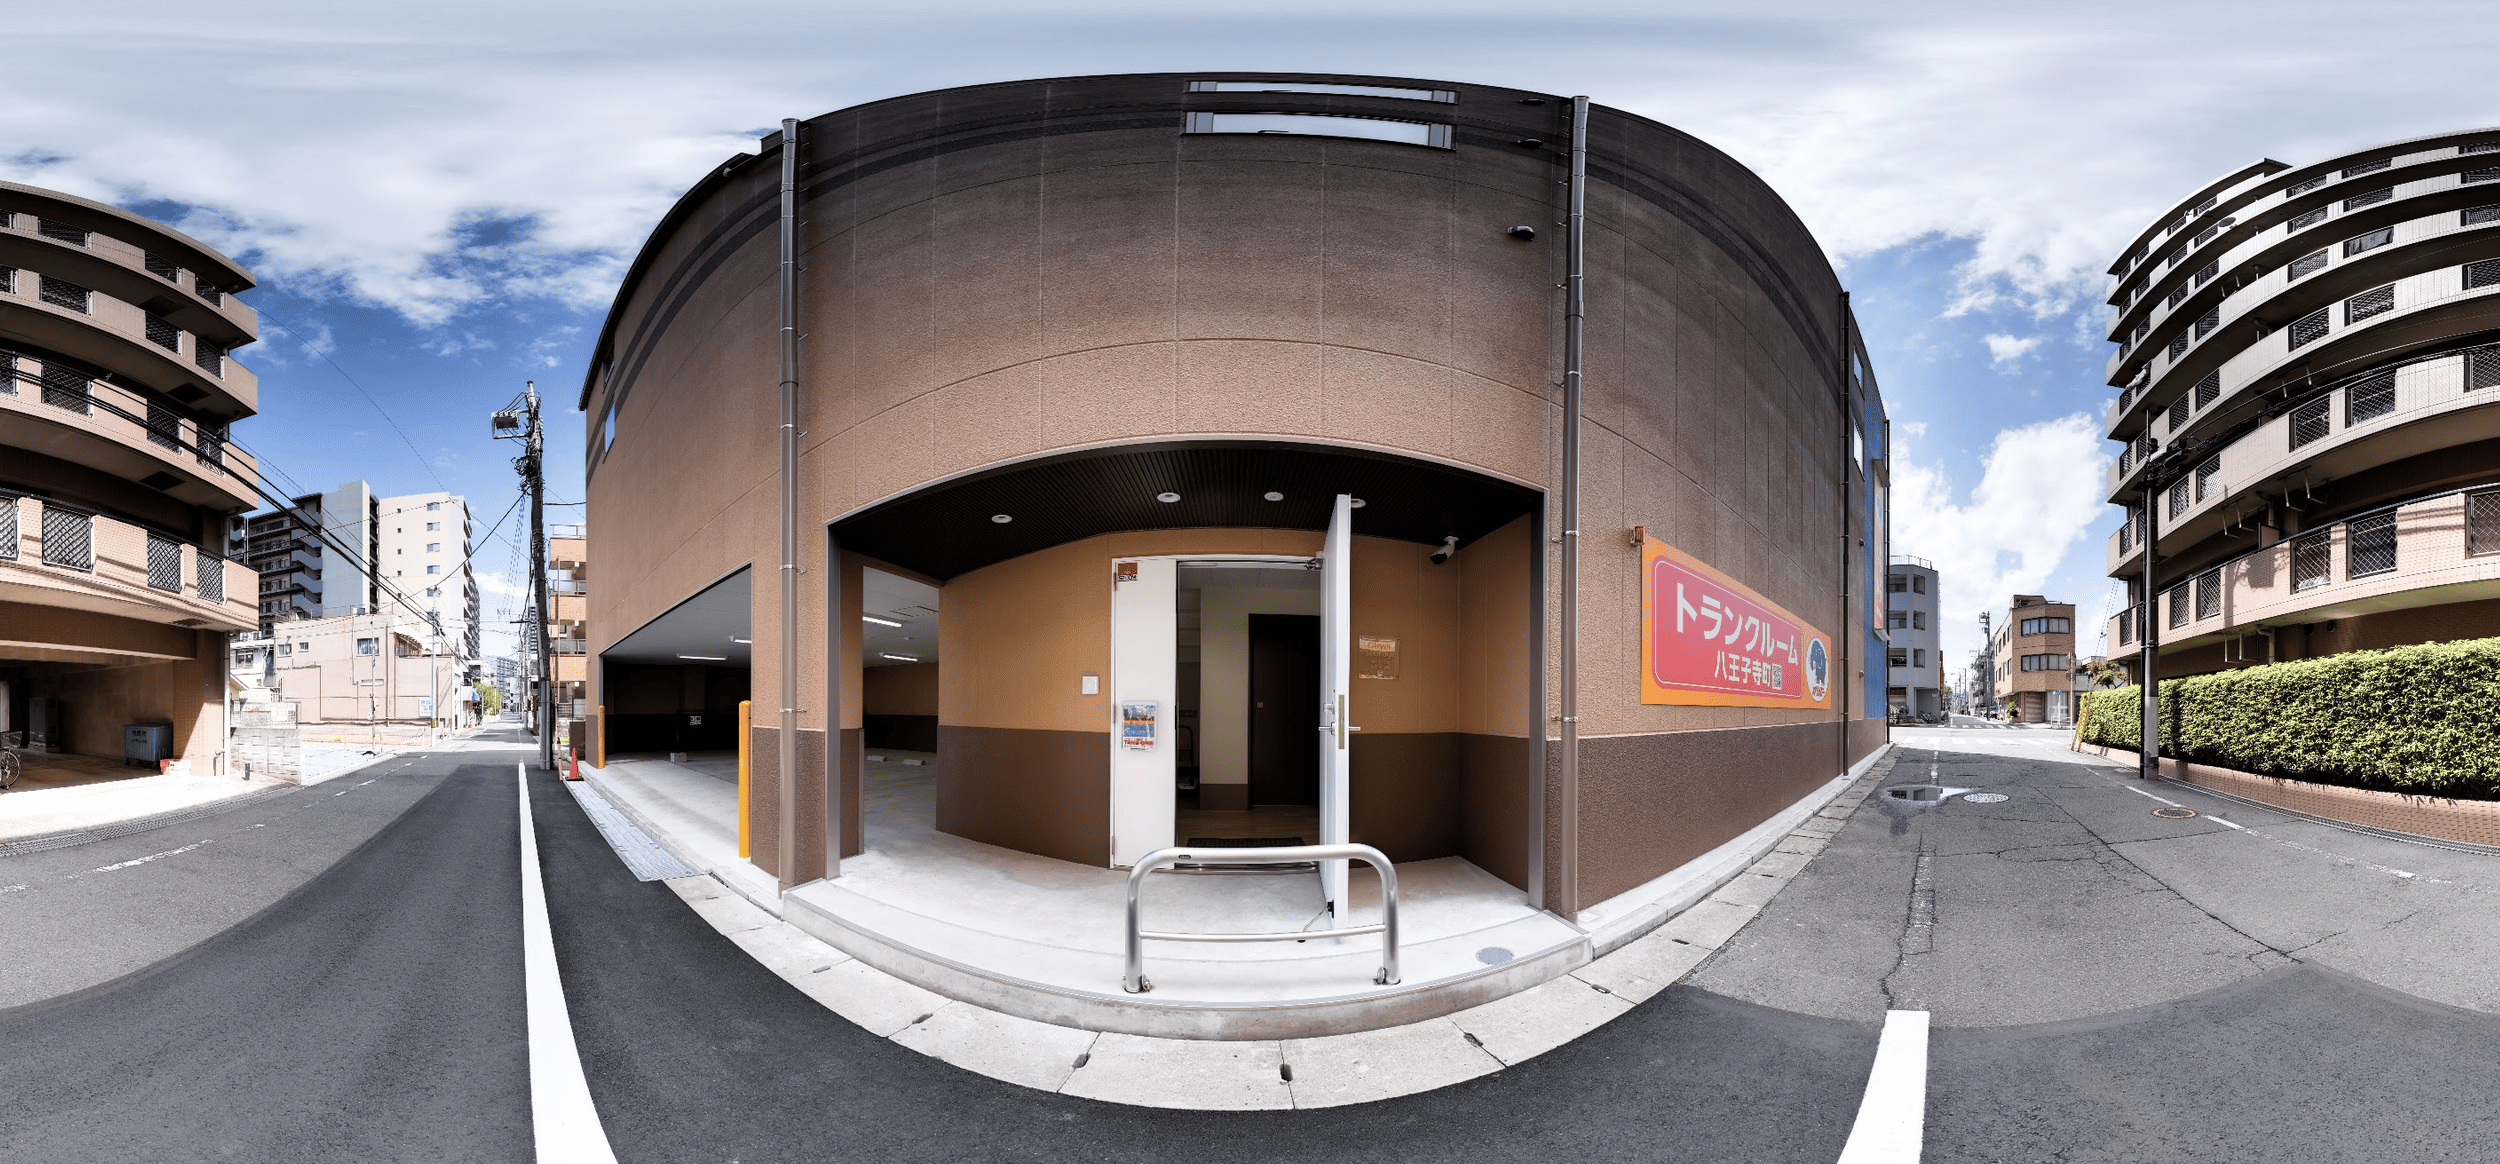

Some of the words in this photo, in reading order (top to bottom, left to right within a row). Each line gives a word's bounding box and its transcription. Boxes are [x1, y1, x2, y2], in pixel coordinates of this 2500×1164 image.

[1676, 582, 1799, 665] トランクルーム
[1714, 650, 1772, 687] 八王子寺町
